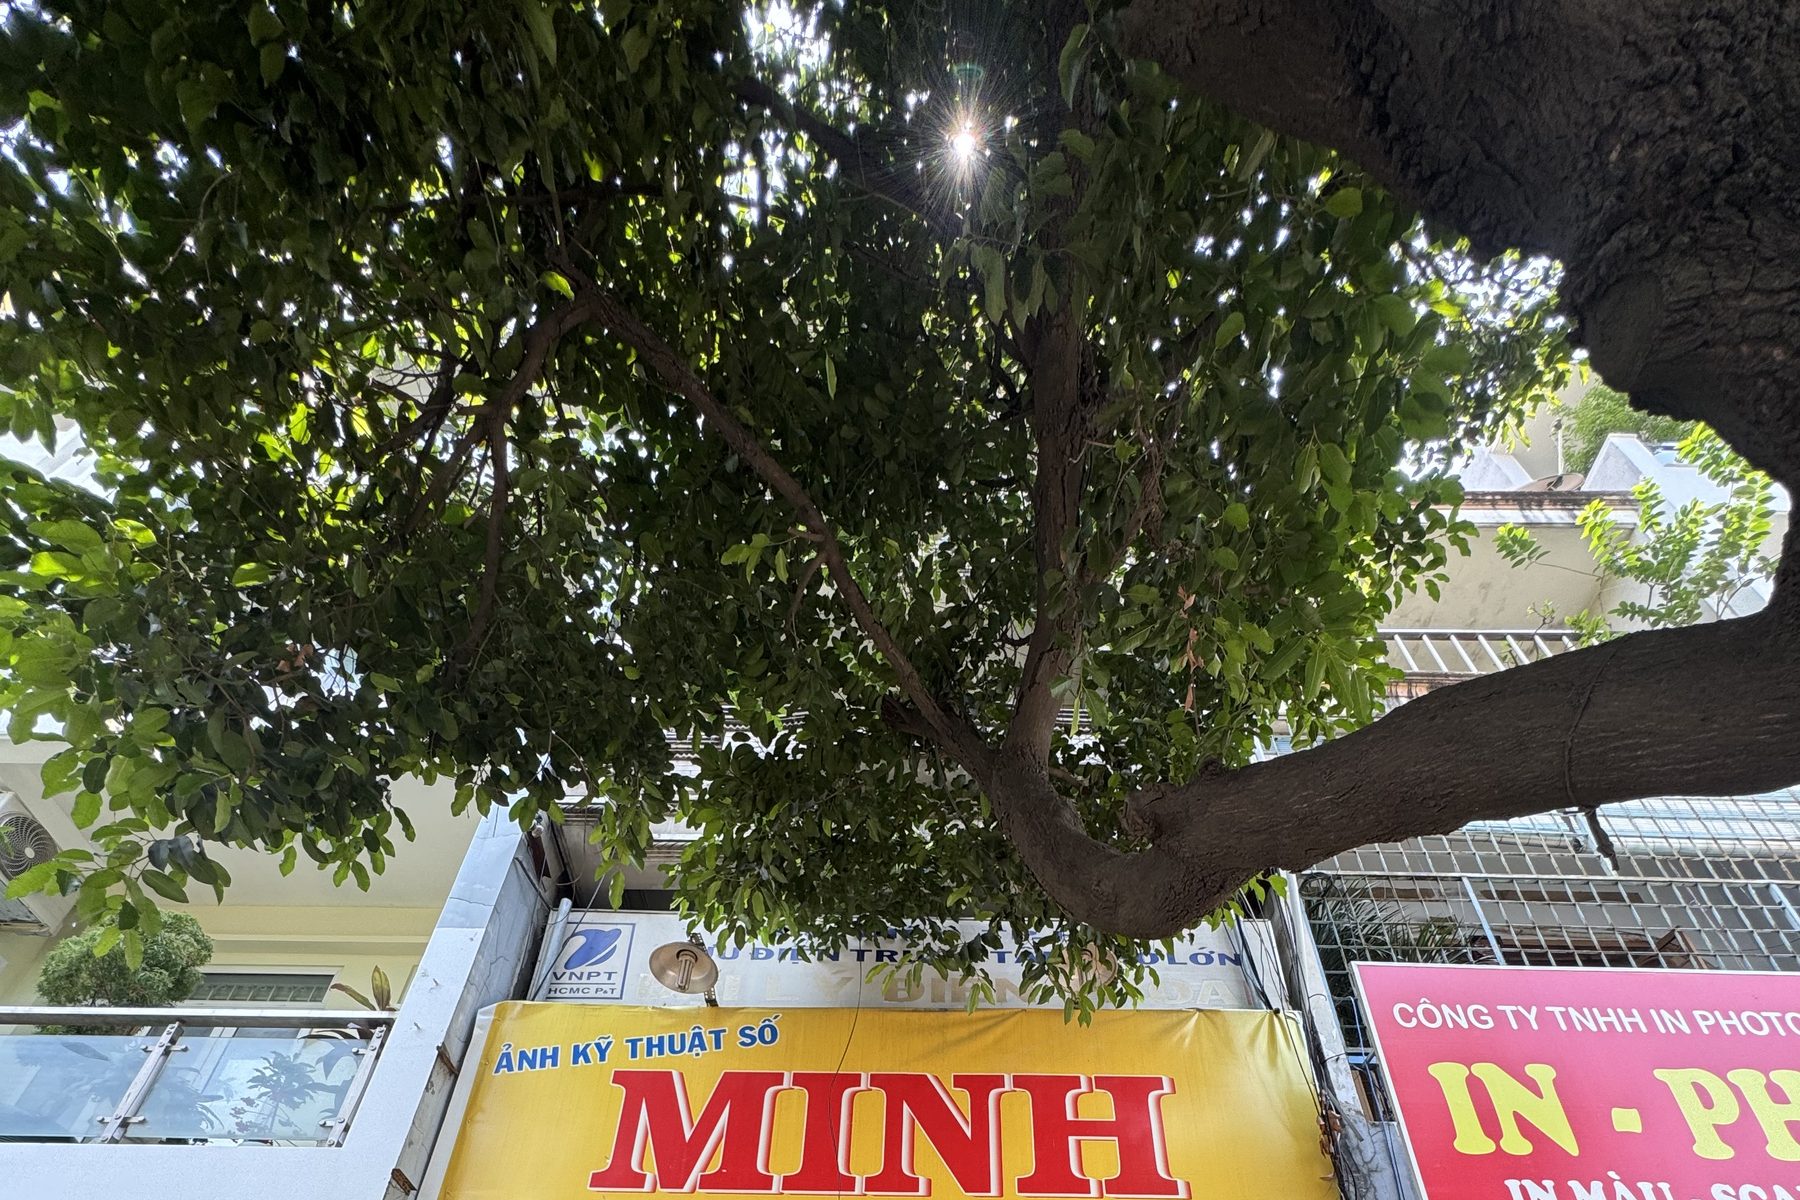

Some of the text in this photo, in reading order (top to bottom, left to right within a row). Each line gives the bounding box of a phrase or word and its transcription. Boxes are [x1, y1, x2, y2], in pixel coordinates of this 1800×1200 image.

[548, 987, 617, 995] HCMC P&T
[552, 971, 618, 981] VNPT
[1393, 997, 1495, 1030] CÔNG
[1497, 1005, 1540, 1031] TY
[1545, 1006, 1648, 1034] TNHH
[1648, 1008, 1692, 1035] IN
[493, 1014, 782, 1075] ẢNH KỸ THUẬT SỐ
[1427, 1061, 1580, 1157] IN
[587, 1070, 1191, 1200] MINH
